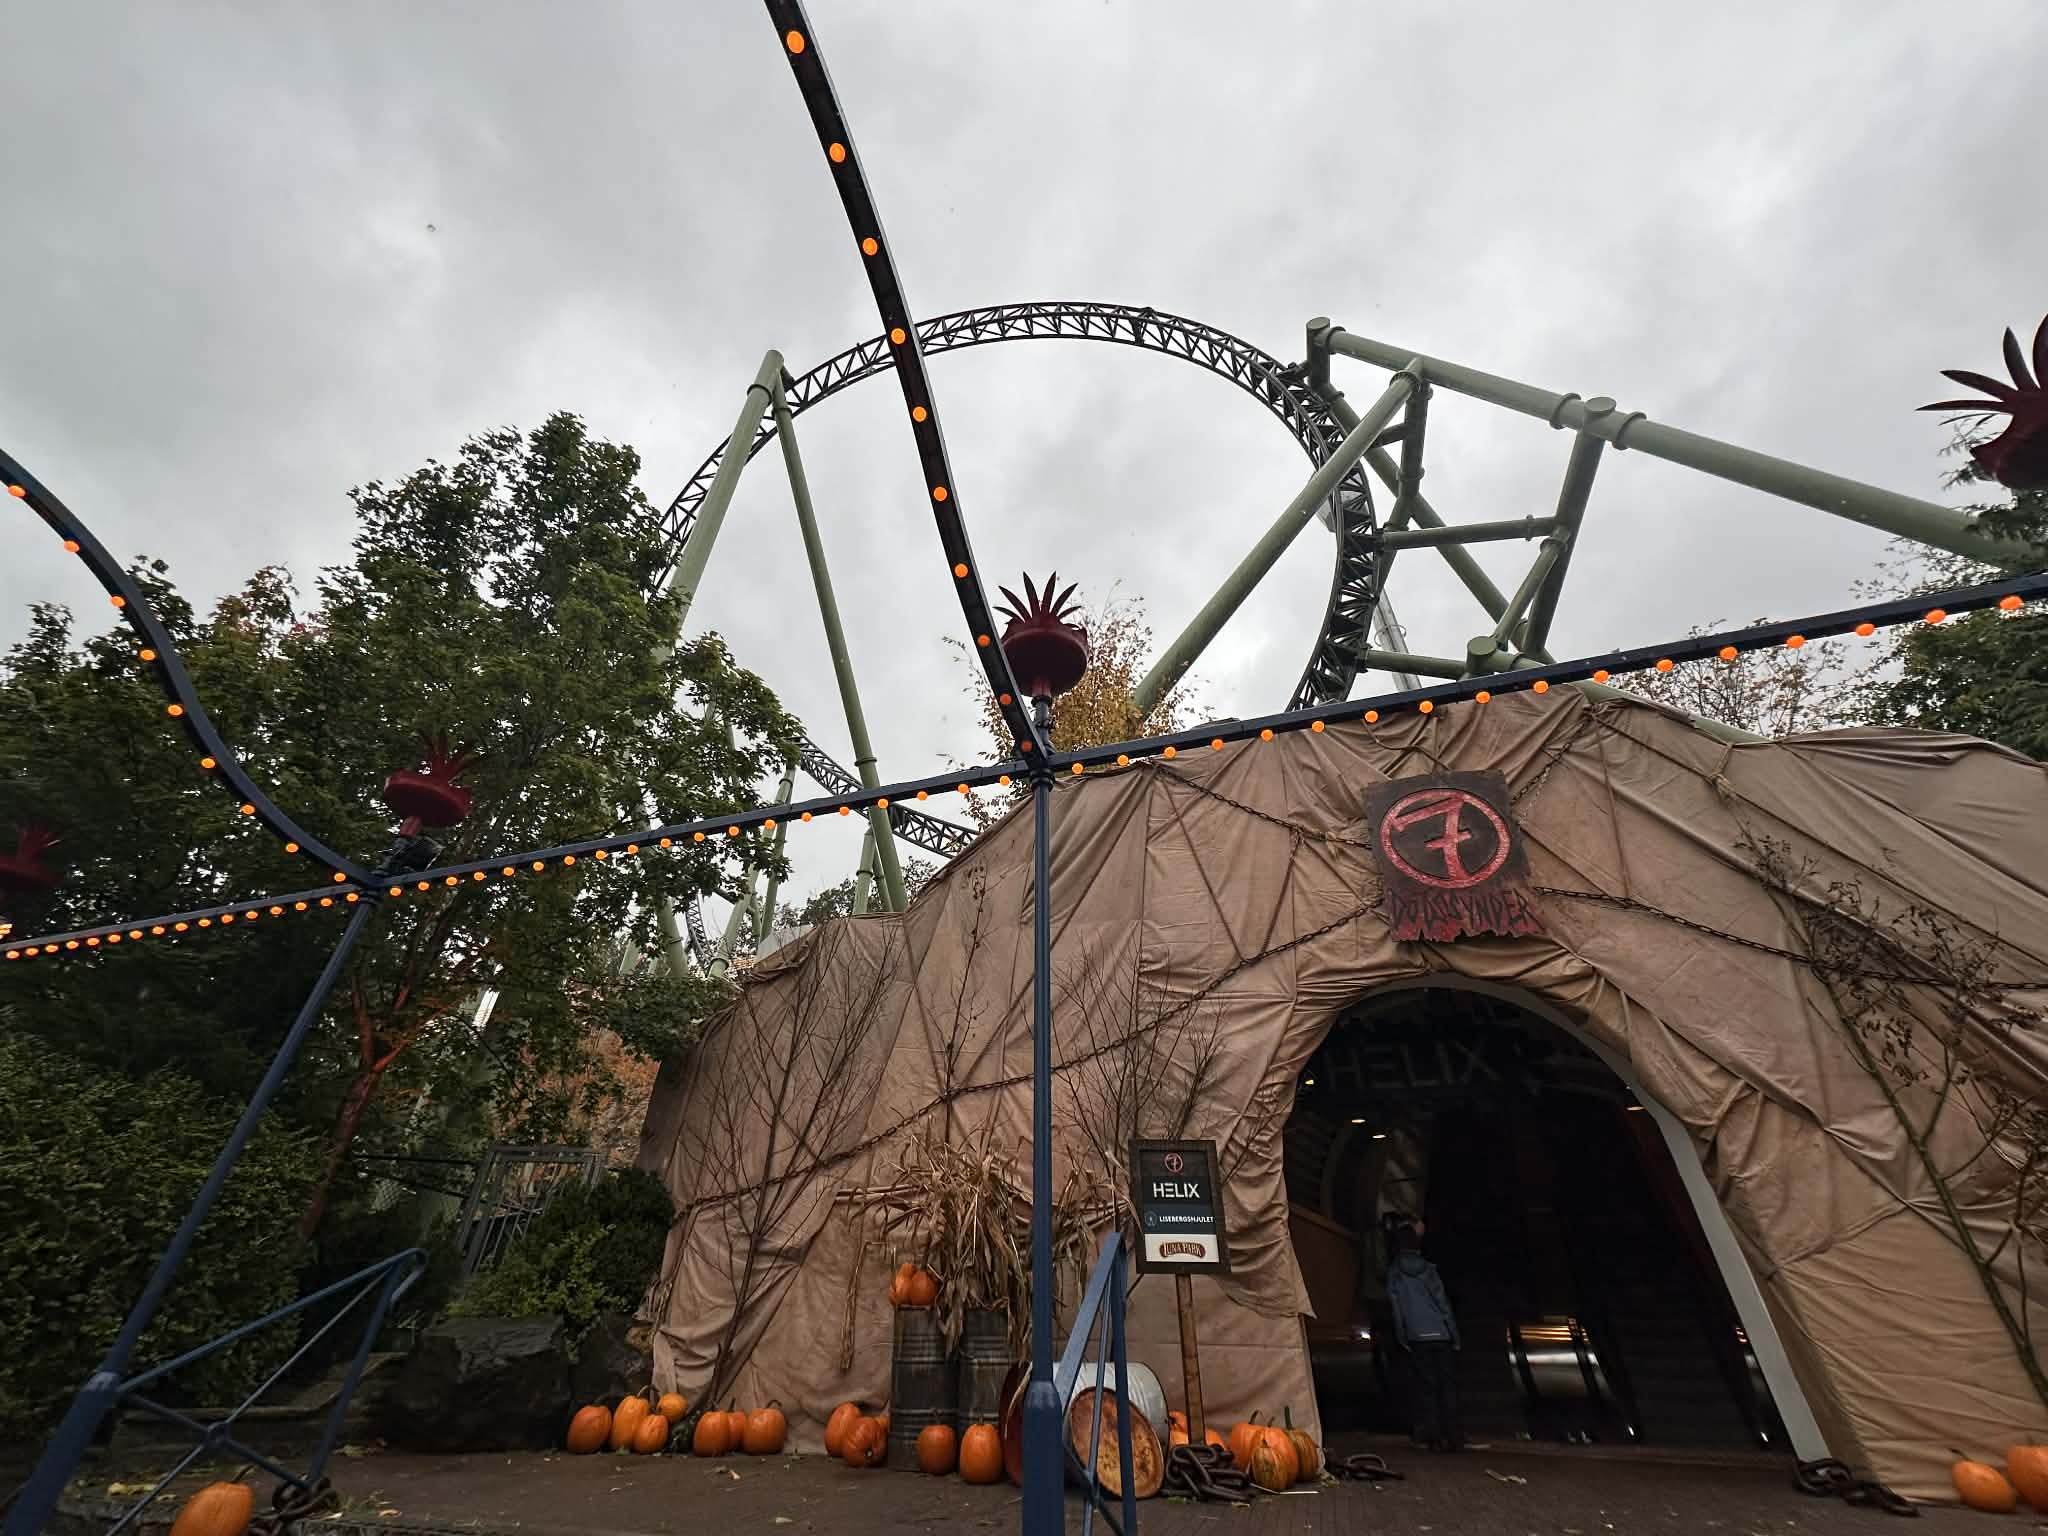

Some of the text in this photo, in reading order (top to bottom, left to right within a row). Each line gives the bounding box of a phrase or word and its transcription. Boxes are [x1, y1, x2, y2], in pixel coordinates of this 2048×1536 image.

[1325, 1040, 1503, 1091] HELIX
[1153, 1182, 1200, 1198] HELIX
[1163, 1242, 1202, 1257] LUNA PARK
